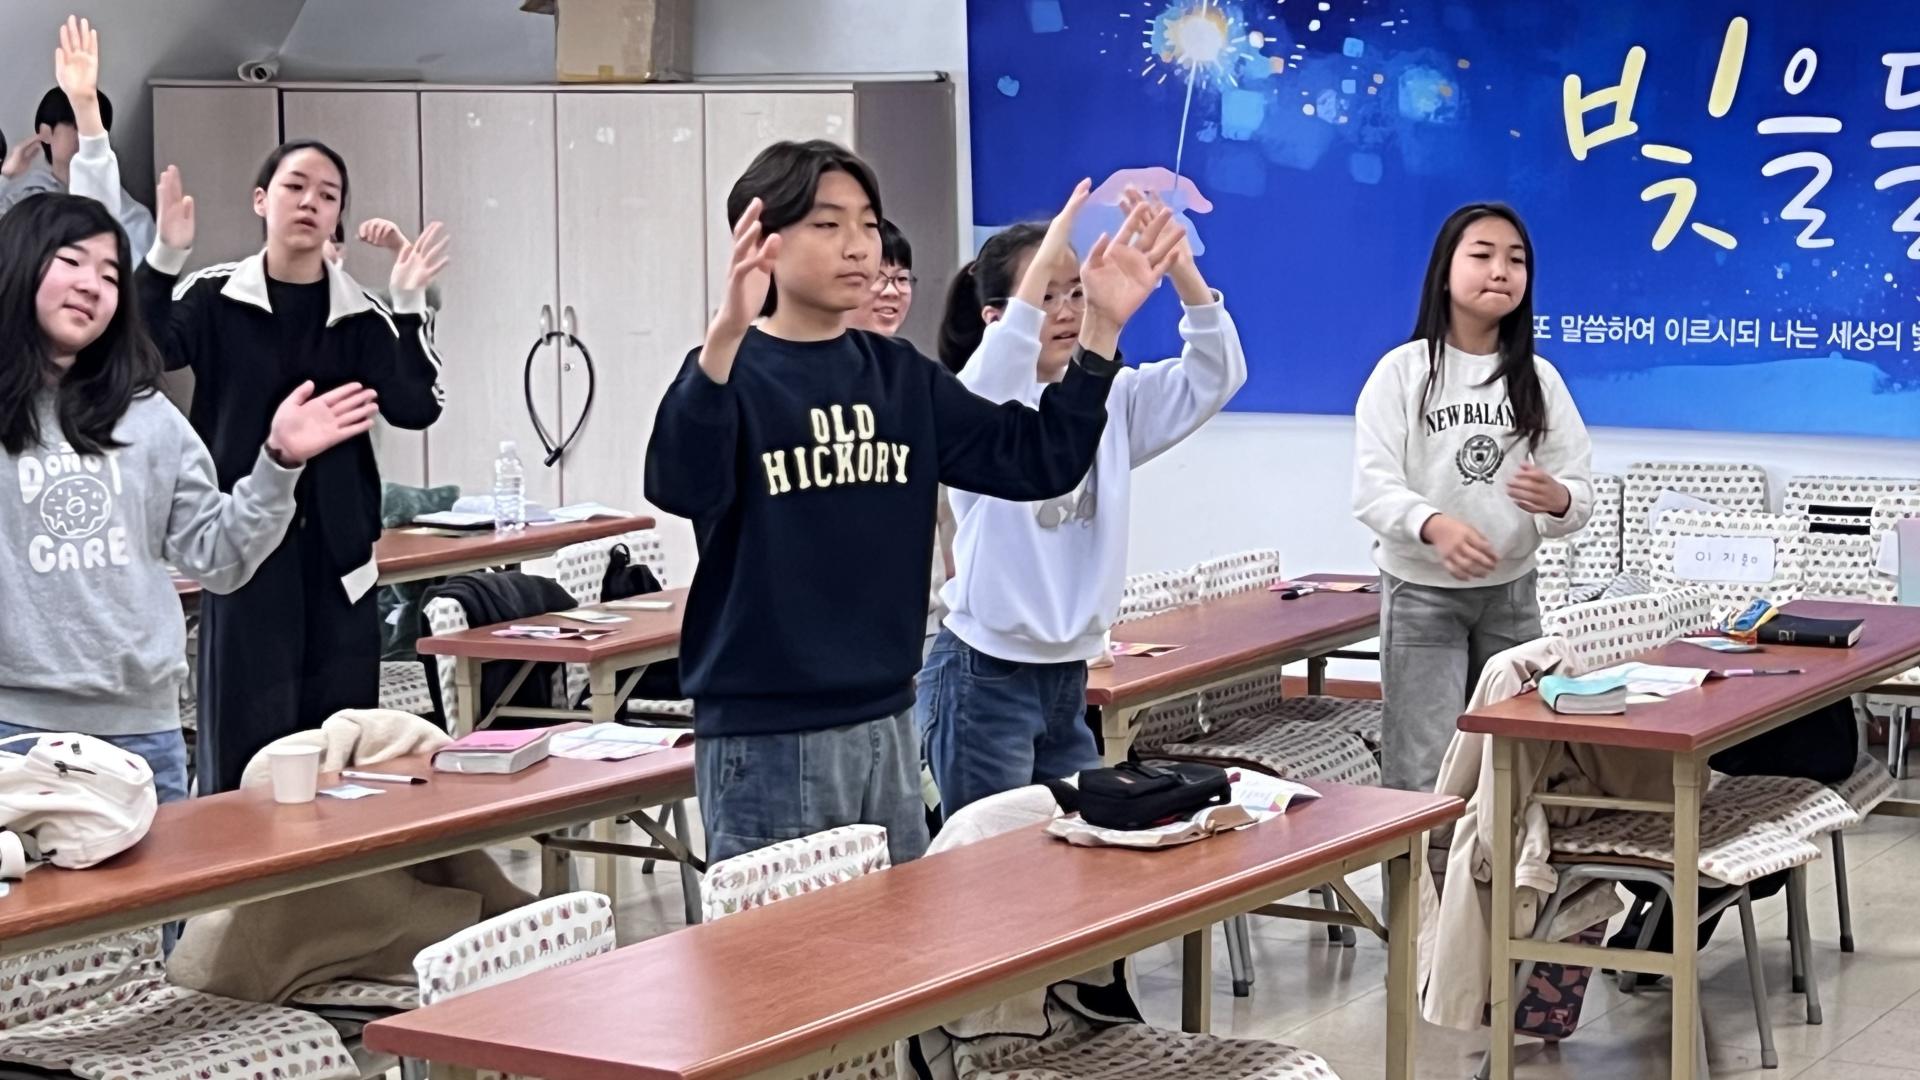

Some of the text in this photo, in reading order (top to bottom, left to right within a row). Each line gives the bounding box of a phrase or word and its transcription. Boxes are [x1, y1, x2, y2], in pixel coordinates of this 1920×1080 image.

[1561, 314, 1655, 345] 말씀하여
[1665, 317, 1760, 348] 이르시되
[1770, 319, 1819, 349] 나는
[1826, 321, 1901, 352] 세상의
[810, 404, 875, 444] OLD
[1425, 403, 1516, 437] NEW BALAN
[762, 441, 910, 496] HICKORY
[29, 527, 130, 573] CARE
